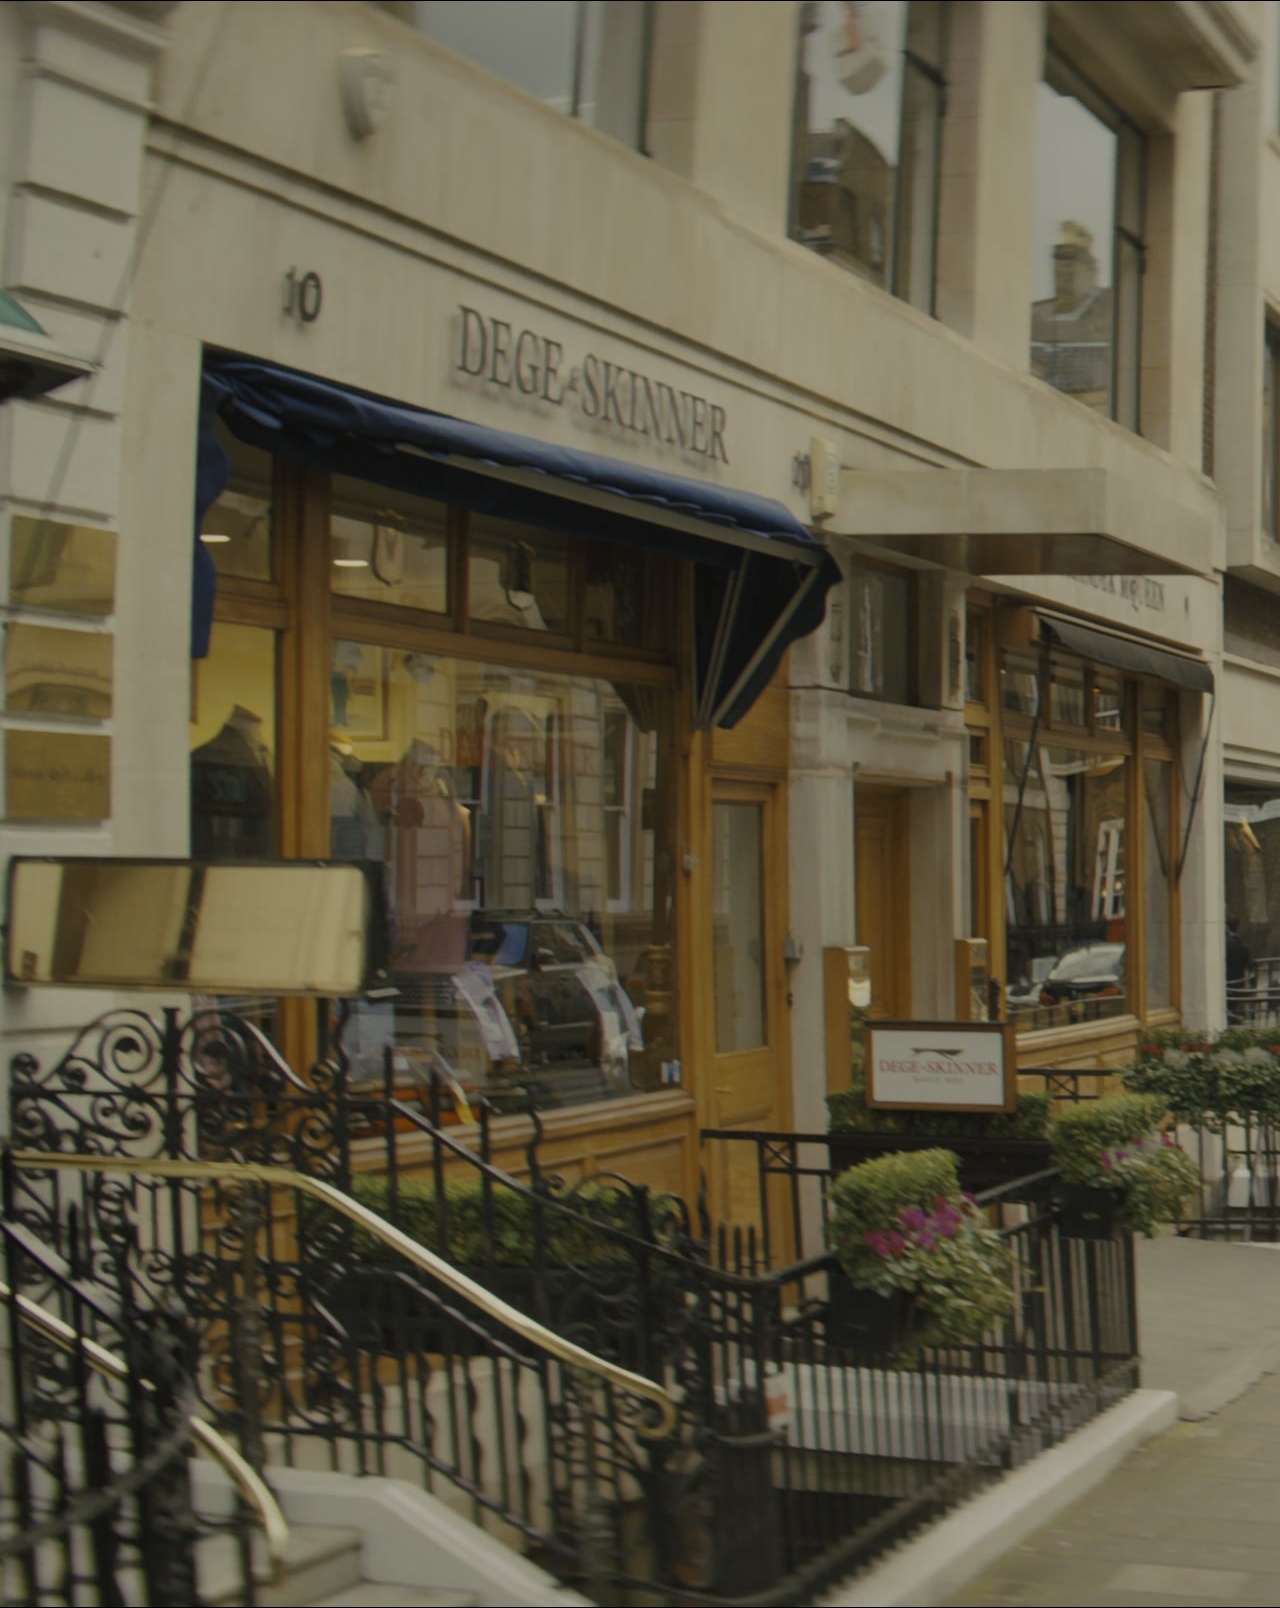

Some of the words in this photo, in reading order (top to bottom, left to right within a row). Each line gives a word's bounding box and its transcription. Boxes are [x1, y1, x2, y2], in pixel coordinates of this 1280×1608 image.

[283, 266, 322, 322] 10
[457, 305, 563, 406] DEGE
[566, 366, 578, 392] &
[580, 352, 729, 464] SKINNER
[879, 1060, 921, 1073] DEGE
[927, 1060, 998, 1075] SKINNER
